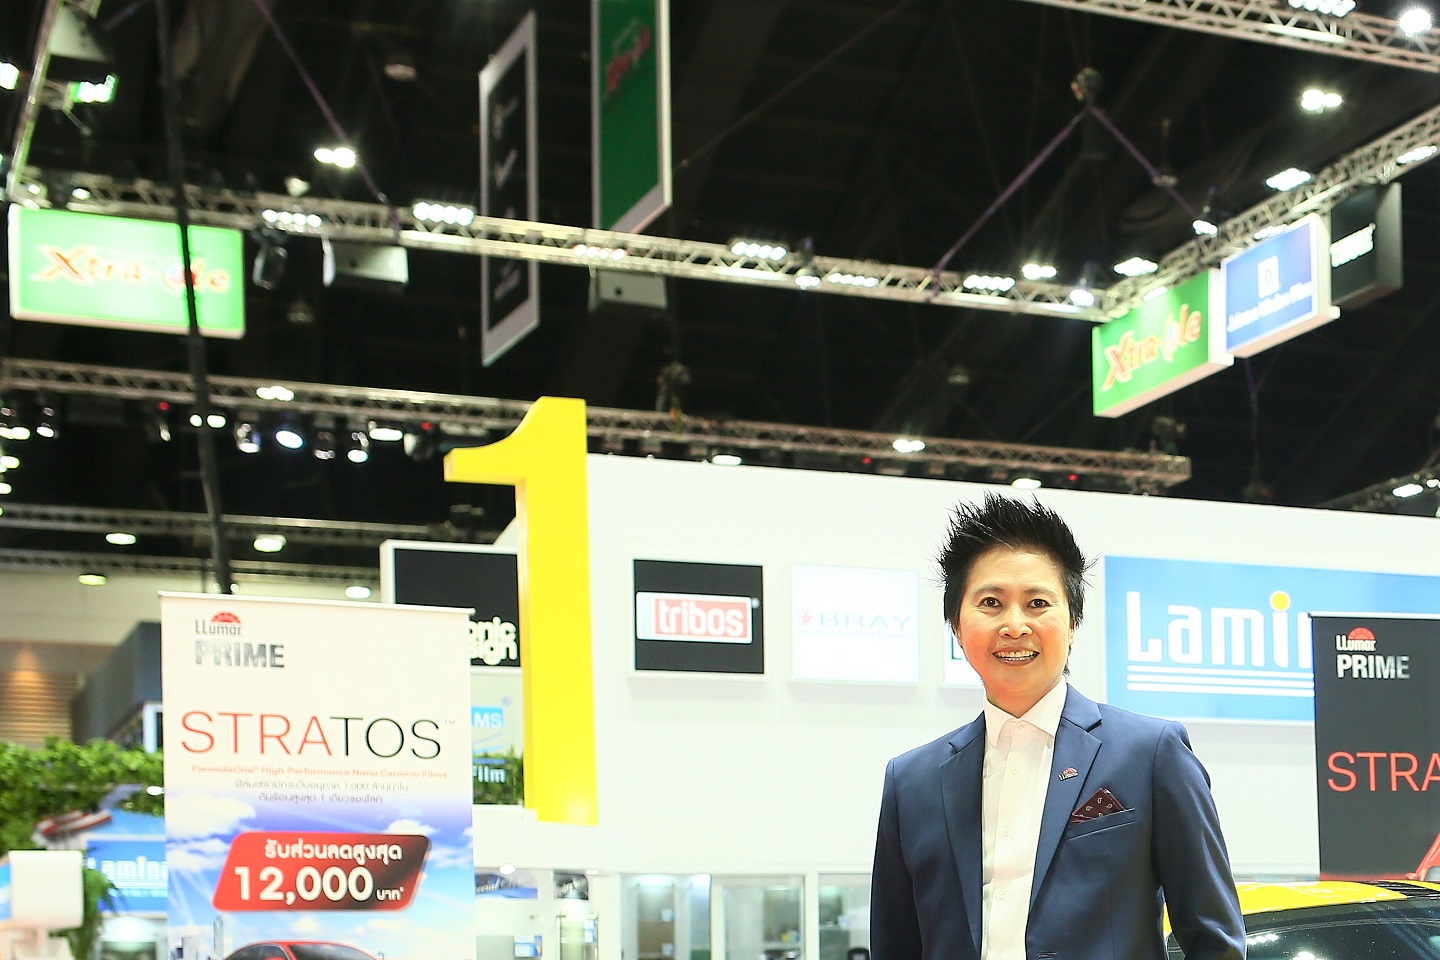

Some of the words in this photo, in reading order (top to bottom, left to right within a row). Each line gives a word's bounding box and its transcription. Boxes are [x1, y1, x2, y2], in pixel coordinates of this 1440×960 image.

[658, 599, 745, 637] tribos
[1125, 589, 1313, 669] Lami
[194, 640, 285, 669] PRIME
[1336, 654, 1411, 680] PRIME
[264, 837, 403, 866] รับส่วนลดสูงสุด
[234, 865, 374, 906] 12,000
